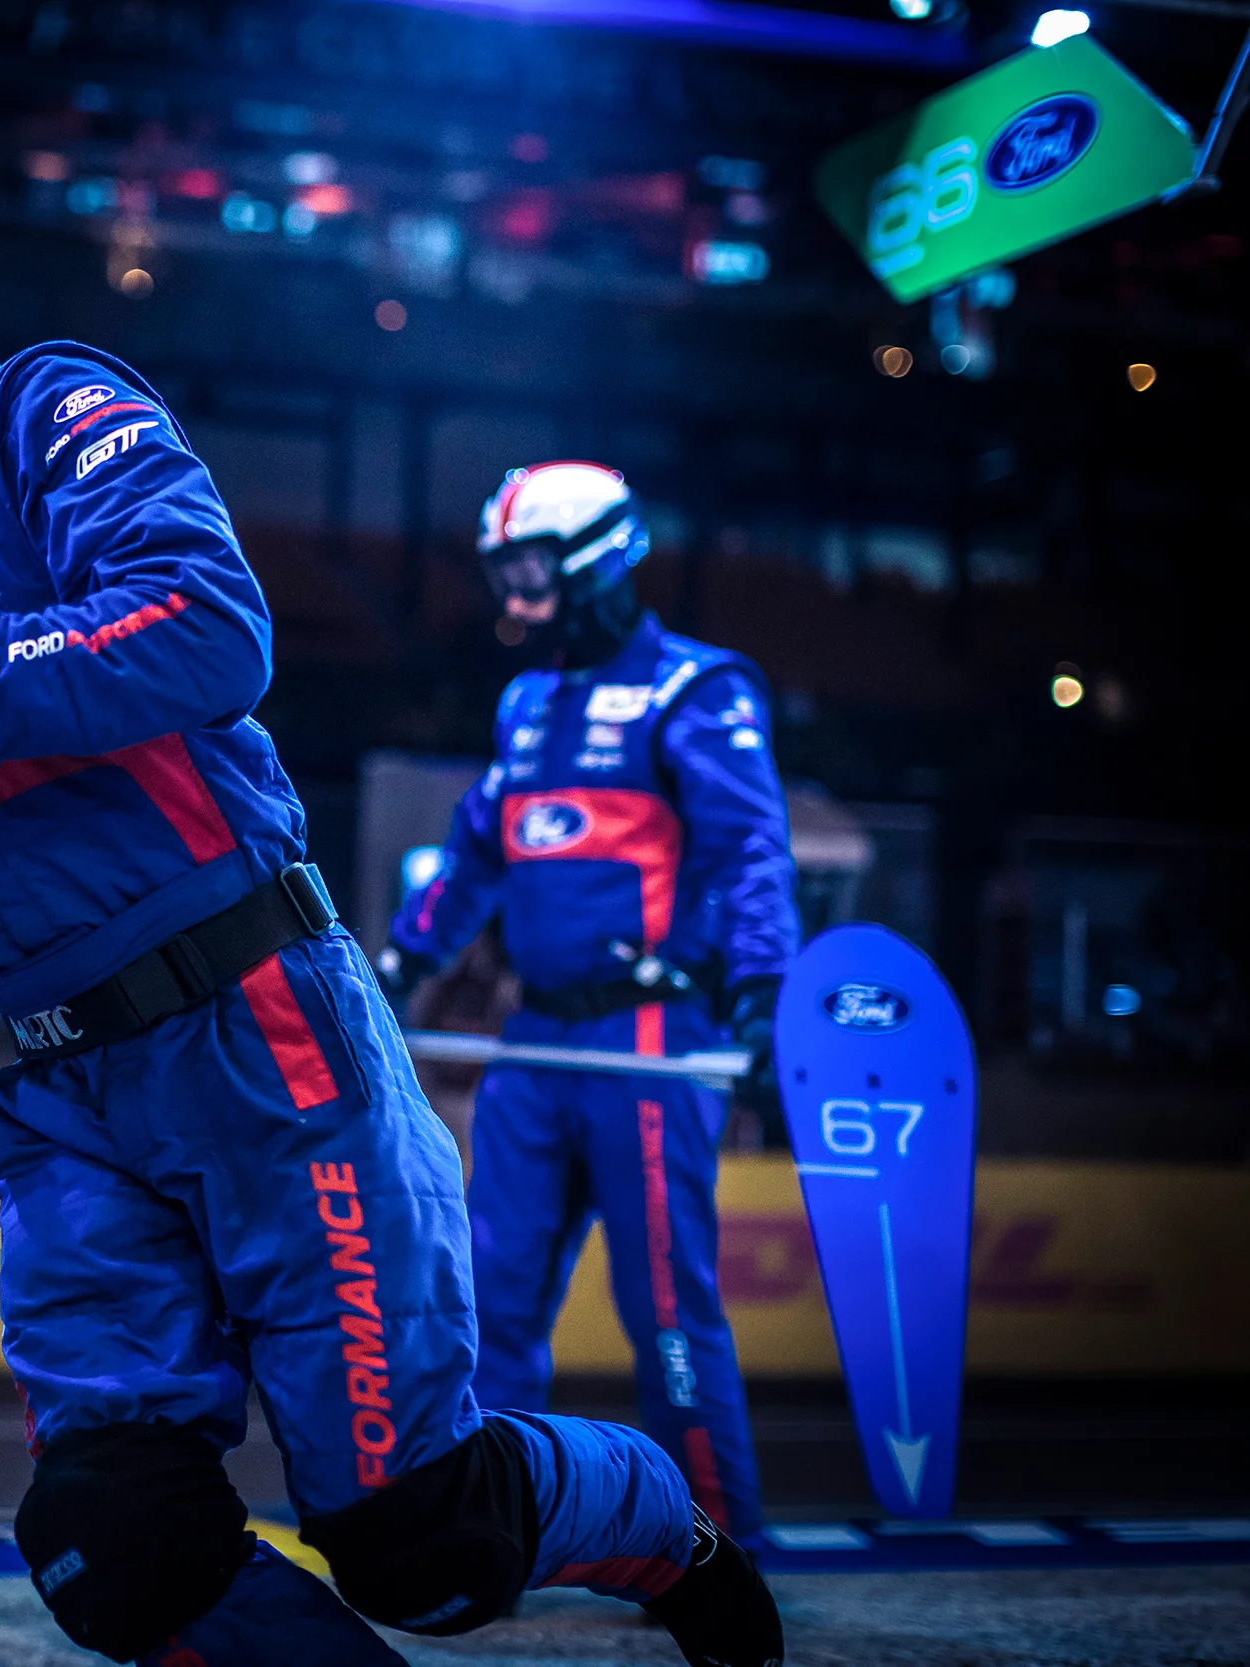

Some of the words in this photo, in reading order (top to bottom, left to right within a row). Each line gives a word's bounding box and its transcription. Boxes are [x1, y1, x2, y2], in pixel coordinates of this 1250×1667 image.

[1003, 112, 1078, 181] Ford
[867, 136, 979, 252] 66
[65, 388, 105, 417] Ford
[77, 421, 159, 480] GT
[8, 630, 65, 663] FORD
[834, 983, 897, 1027] Ford
[820, 1098, 925, 1158] 67
